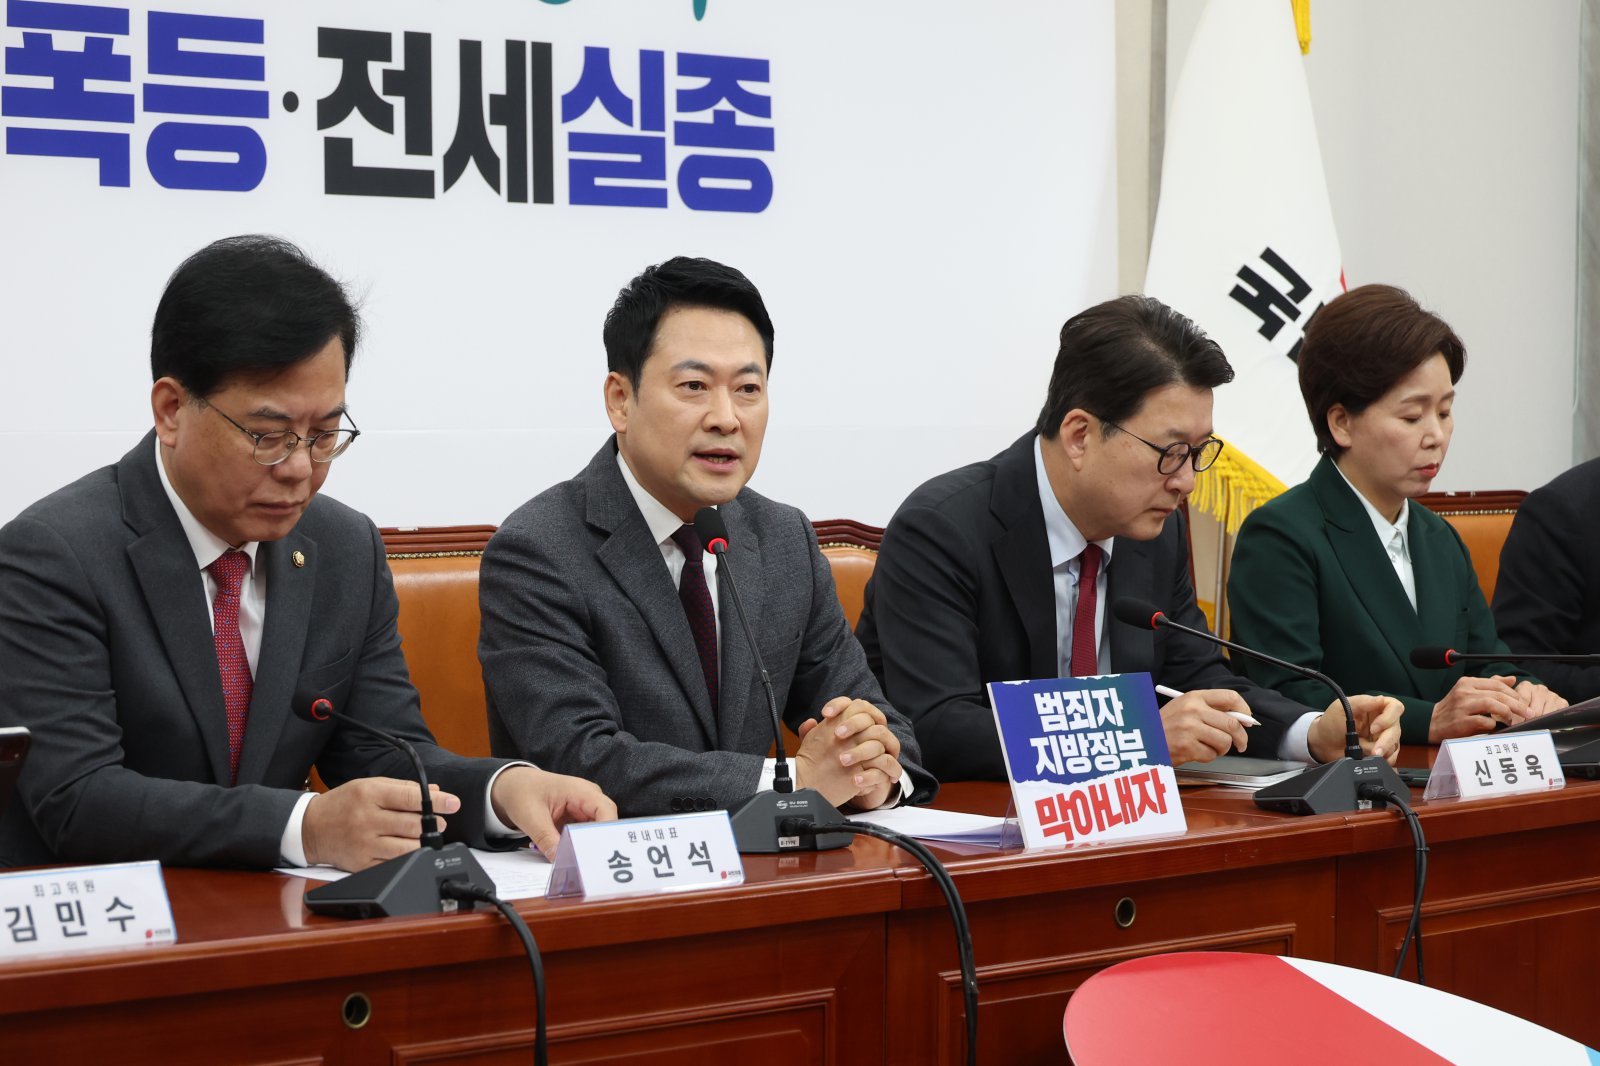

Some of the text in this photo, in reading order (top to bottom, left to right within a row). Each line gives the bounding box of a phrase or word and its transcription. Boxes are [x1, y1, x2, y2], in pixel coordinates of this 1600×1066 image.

[1033, 687, 1125, 732] 범죄자
[1029, 728, 1148, 776] 지방정부
[1035, 767, 1168, 842] 막아내자
[627, 827, 679, 843] 원내대표
